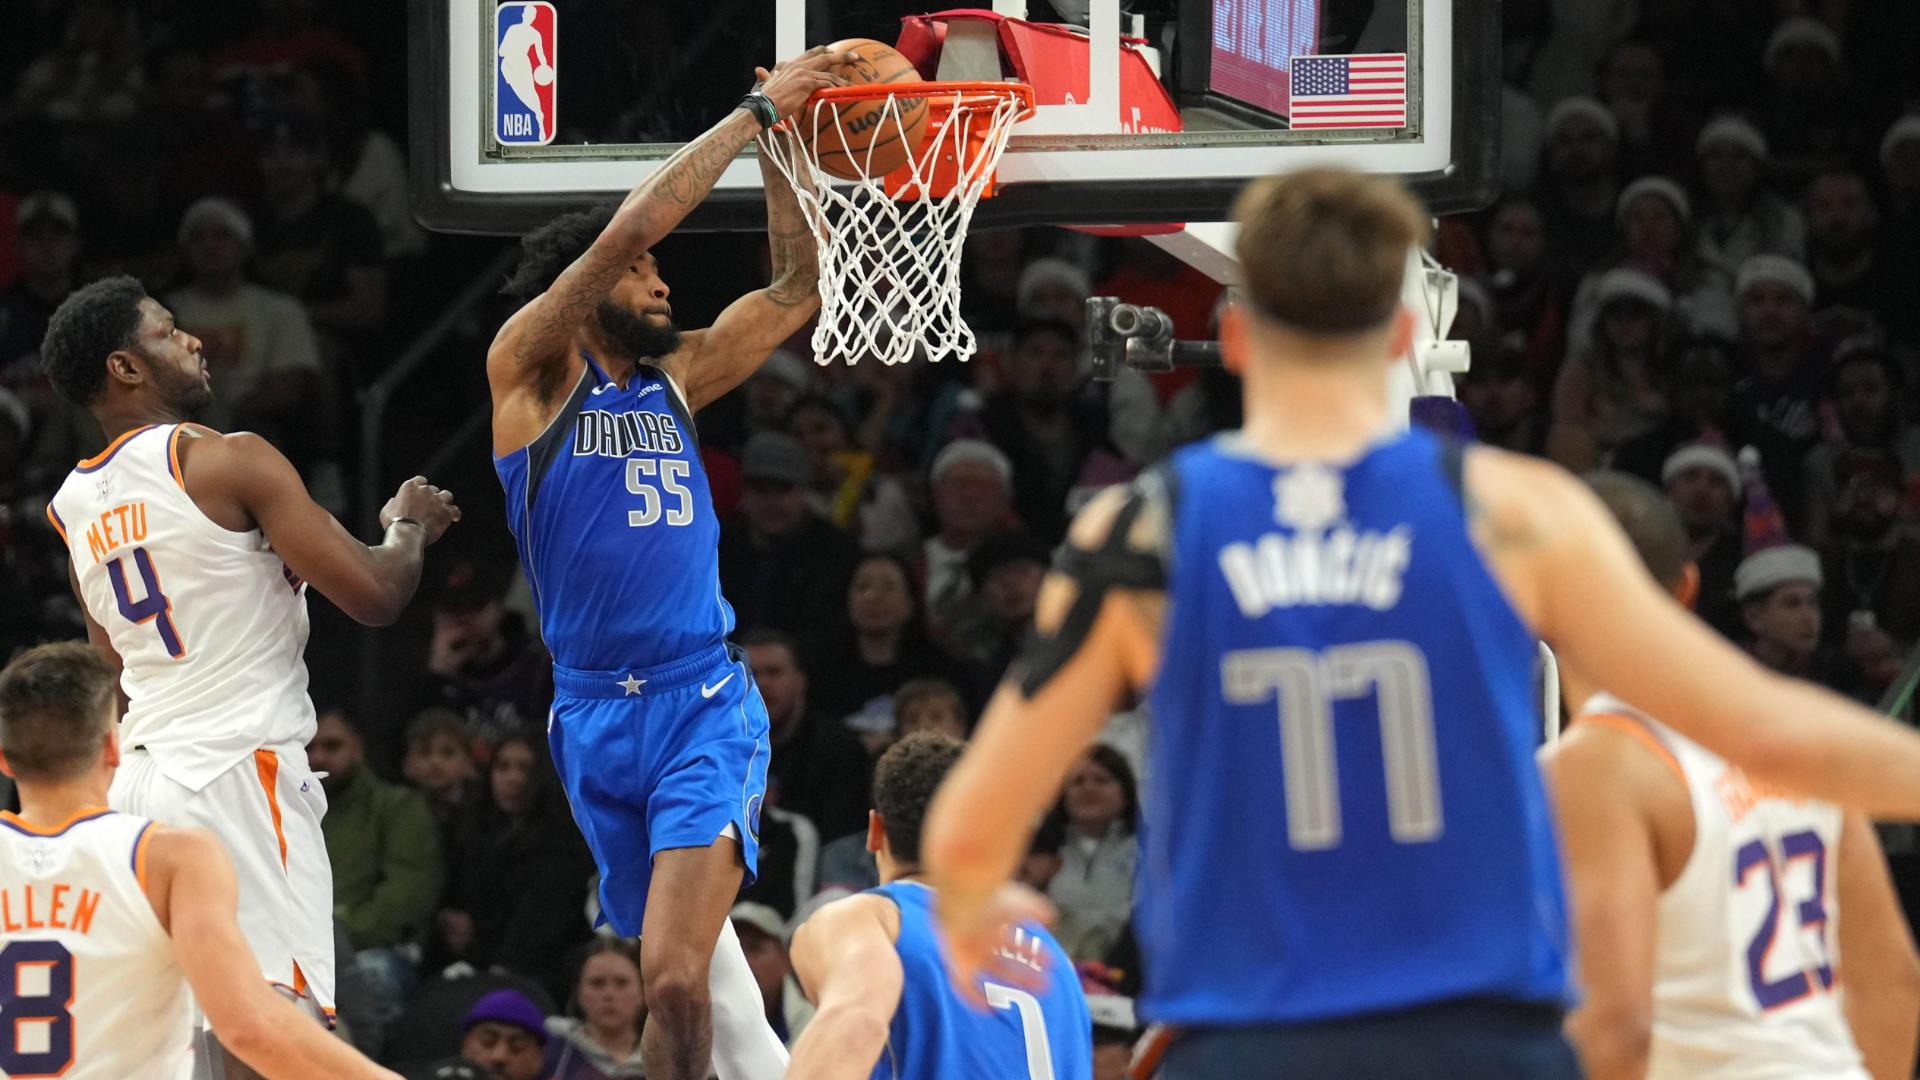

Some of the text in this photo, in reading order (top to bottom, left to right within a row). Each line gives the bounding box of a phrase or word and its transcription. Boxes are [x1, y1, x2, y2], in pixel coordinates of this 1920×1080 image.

[503, 113, 532, 136] NBA
[573, 409, 683, 458] DALLAS
[625, 458, 694, 528] 55
[86, 502, 148, 564] METU
[106, 546, 187, 660] 4
[1220, 638, 1445, 851] 77
[0, 882, 101, 935] LLEN
[1733, 830, 1836, 1018] 23
[983, 981, 1056, 1080] 7
